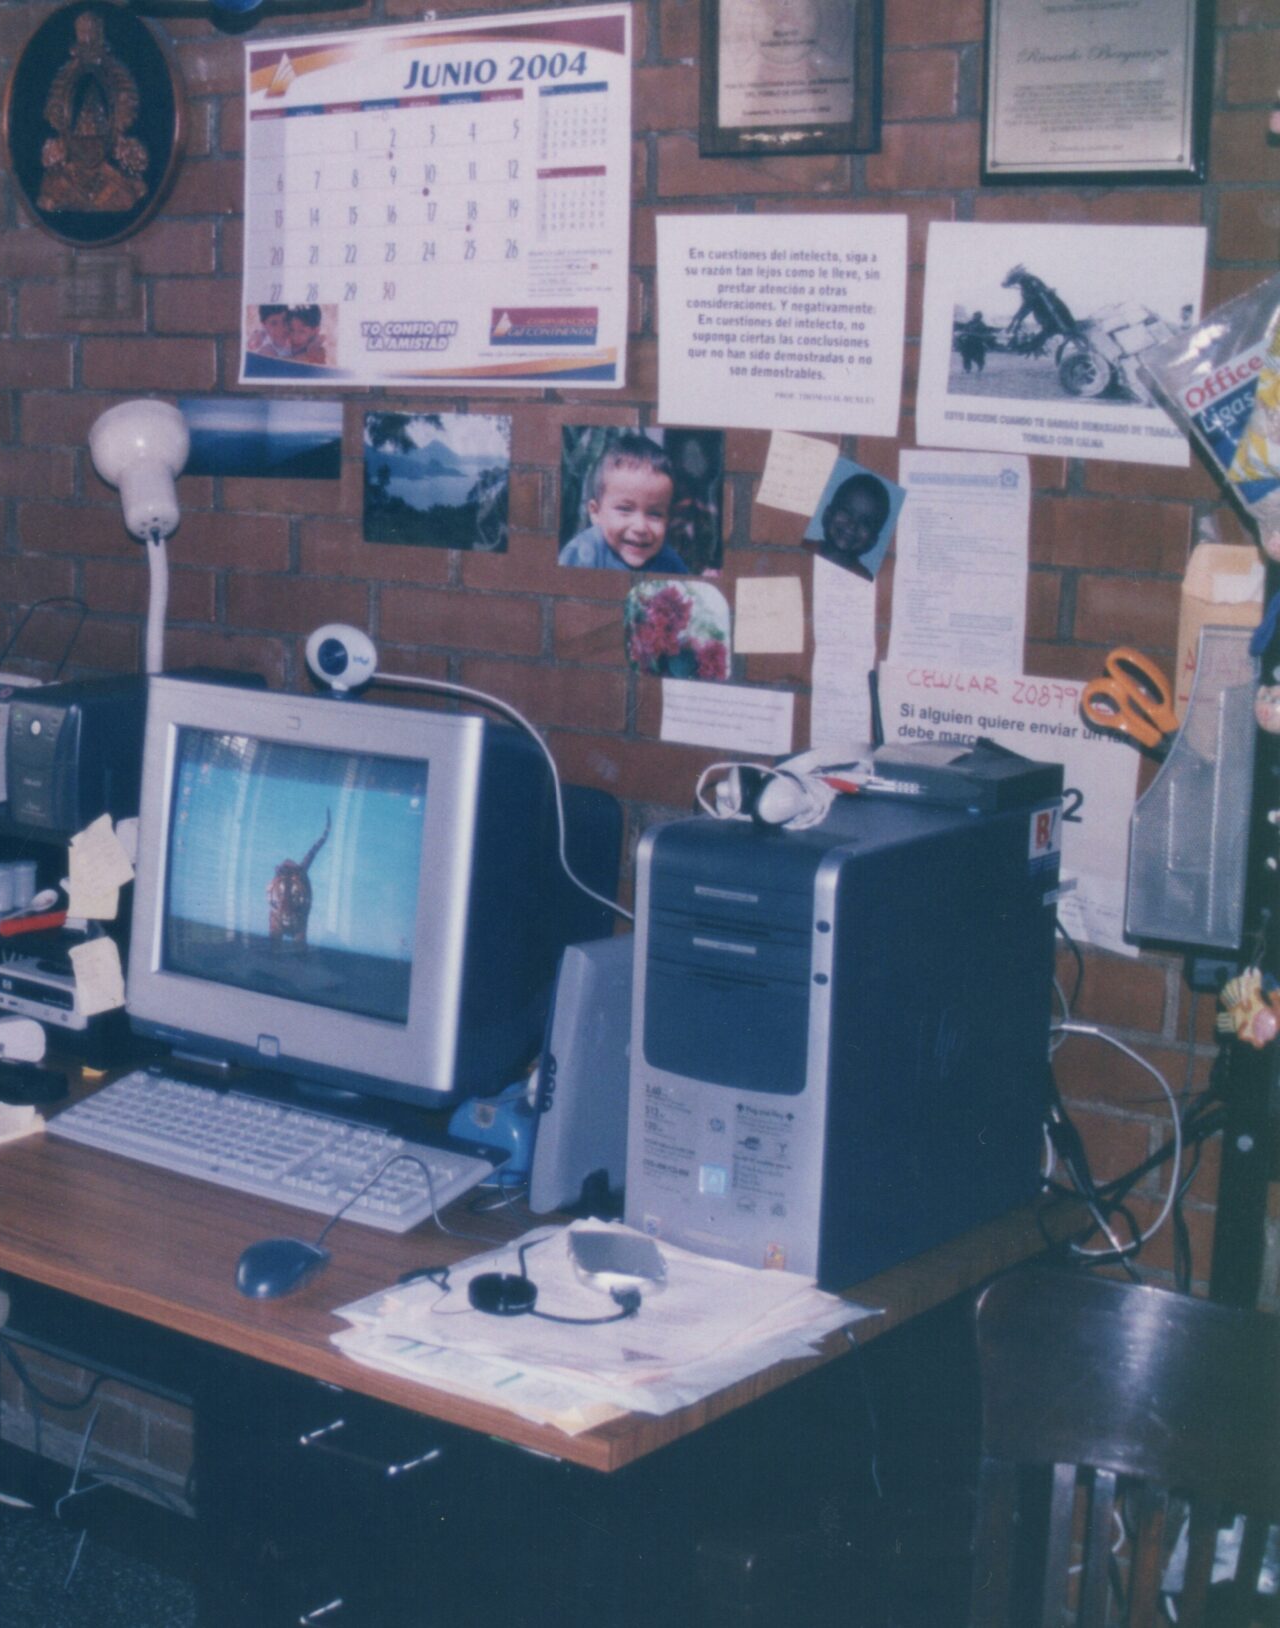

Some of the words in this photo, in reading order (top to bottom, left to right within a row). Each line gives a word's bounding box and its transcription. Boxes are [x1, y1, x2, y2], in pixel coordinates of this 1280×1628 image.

[403, 59, 498, 90] JUNIO
[507, 51, 588, 82] 2004
[389, 128, 397, 149] 2
[429, 124, 436, 145] 3
[468, 122, 476, 141] 4
[512, 119, 519, 139] 5
[314, 170, 320, 190] 7
[389, 166, 397, 186] 9
[424, 163, 436, 183] 10
[508, 159, 519, 179] 12
[309, 207, 319, 227] 14
[348, 205, 358, 226] 15
[386, 204, 397, 224] 16
[427, 202, 437, 222] 17
[467, 201, 478, 221] 18
[508, 198, 519, 218] 19
[271, 246, 284, 267] 20
[308, 245, 319, 265] 21
[344, 244, 358, 264] 22
[384, 242, 397, 263] 23
[422, 240, 436, 262] 24
[464, 240, 476, 261] 25
[505, 238, 519, 260] 26
[688, 248, 704, 260] En
[708, 250, 767, 262] cuestiones
[770, 249, 787, 261] del
[790, 249, 842, 264] intelecto,
[846, 250, 868, 265] siga
[871, 253, 878, 263] a
[684, 266, 698, 276] su
[701, 264, 733, 277] razón
[736, 266, 753, 277] tan
[756, 265, 782, 281] lejos
[785, 268, 815, 279] como
[819, 266, 829, 279] le
[832, 266, 861, 282] lleve,
[864, 268, 881, 280] sin
[270, 283, 283, 302] 27
[306, 282, 319, 302] 28
[344, 282, 358, 301] 29
[383, 281, 396, 301] 30
[717, 284, 756, 296] prestar
[759, 283, 806, 296] atención
[809, 286, 816, 295] a
[818, 285, 847, 297] otras
[780, 300, 788, 311] Y
[361, 321, 381, 337] YO
[383, 320, 438, 337] CONFIO
[438, 320, 459, 337] EN
[697, 314, 713, 325] En
[716, 315, 772, 328] cuestiones
[775, 316, 792, 328] del
[794, 317, 848, 331] intelecto,
[851, 321, 865, 331] no
[388, 336, 450, 352] AMISTAD
[692, 332, 737, 346] suponga
[740, 332, 776, 345] ciertas
[779, 333, 794, 345] las
[797, 334, 869, 348] conclusiones
[687, 348, 708, 361] que
[710, 348, 724, 358] no
[727, 347, 746, 359] han
[749, 349, 770, 361] sido
[774, 350, 844, 364] demostradas
[848, 355, 855, 364] o
[858, 355, 873, 365] no
[729, 366, 748, 377] son
[750, 365, 826, 380] demostrables.
[1185, 356, 1264, 410] Office
[1199, 391, 1256, 434] Ligas
[1035, 417, 1045, 428] TE
[900, 702, 915, 719] Si
[919, 704, 973, 726] alguien
[977, 715, 1026, 732] quiere
[1029, 720, 1078, 738] enviar
[1082, 726, 1102, 742] un
[897, 723, 935, 740] debe
[1061, 787, 1084, 824] 2
